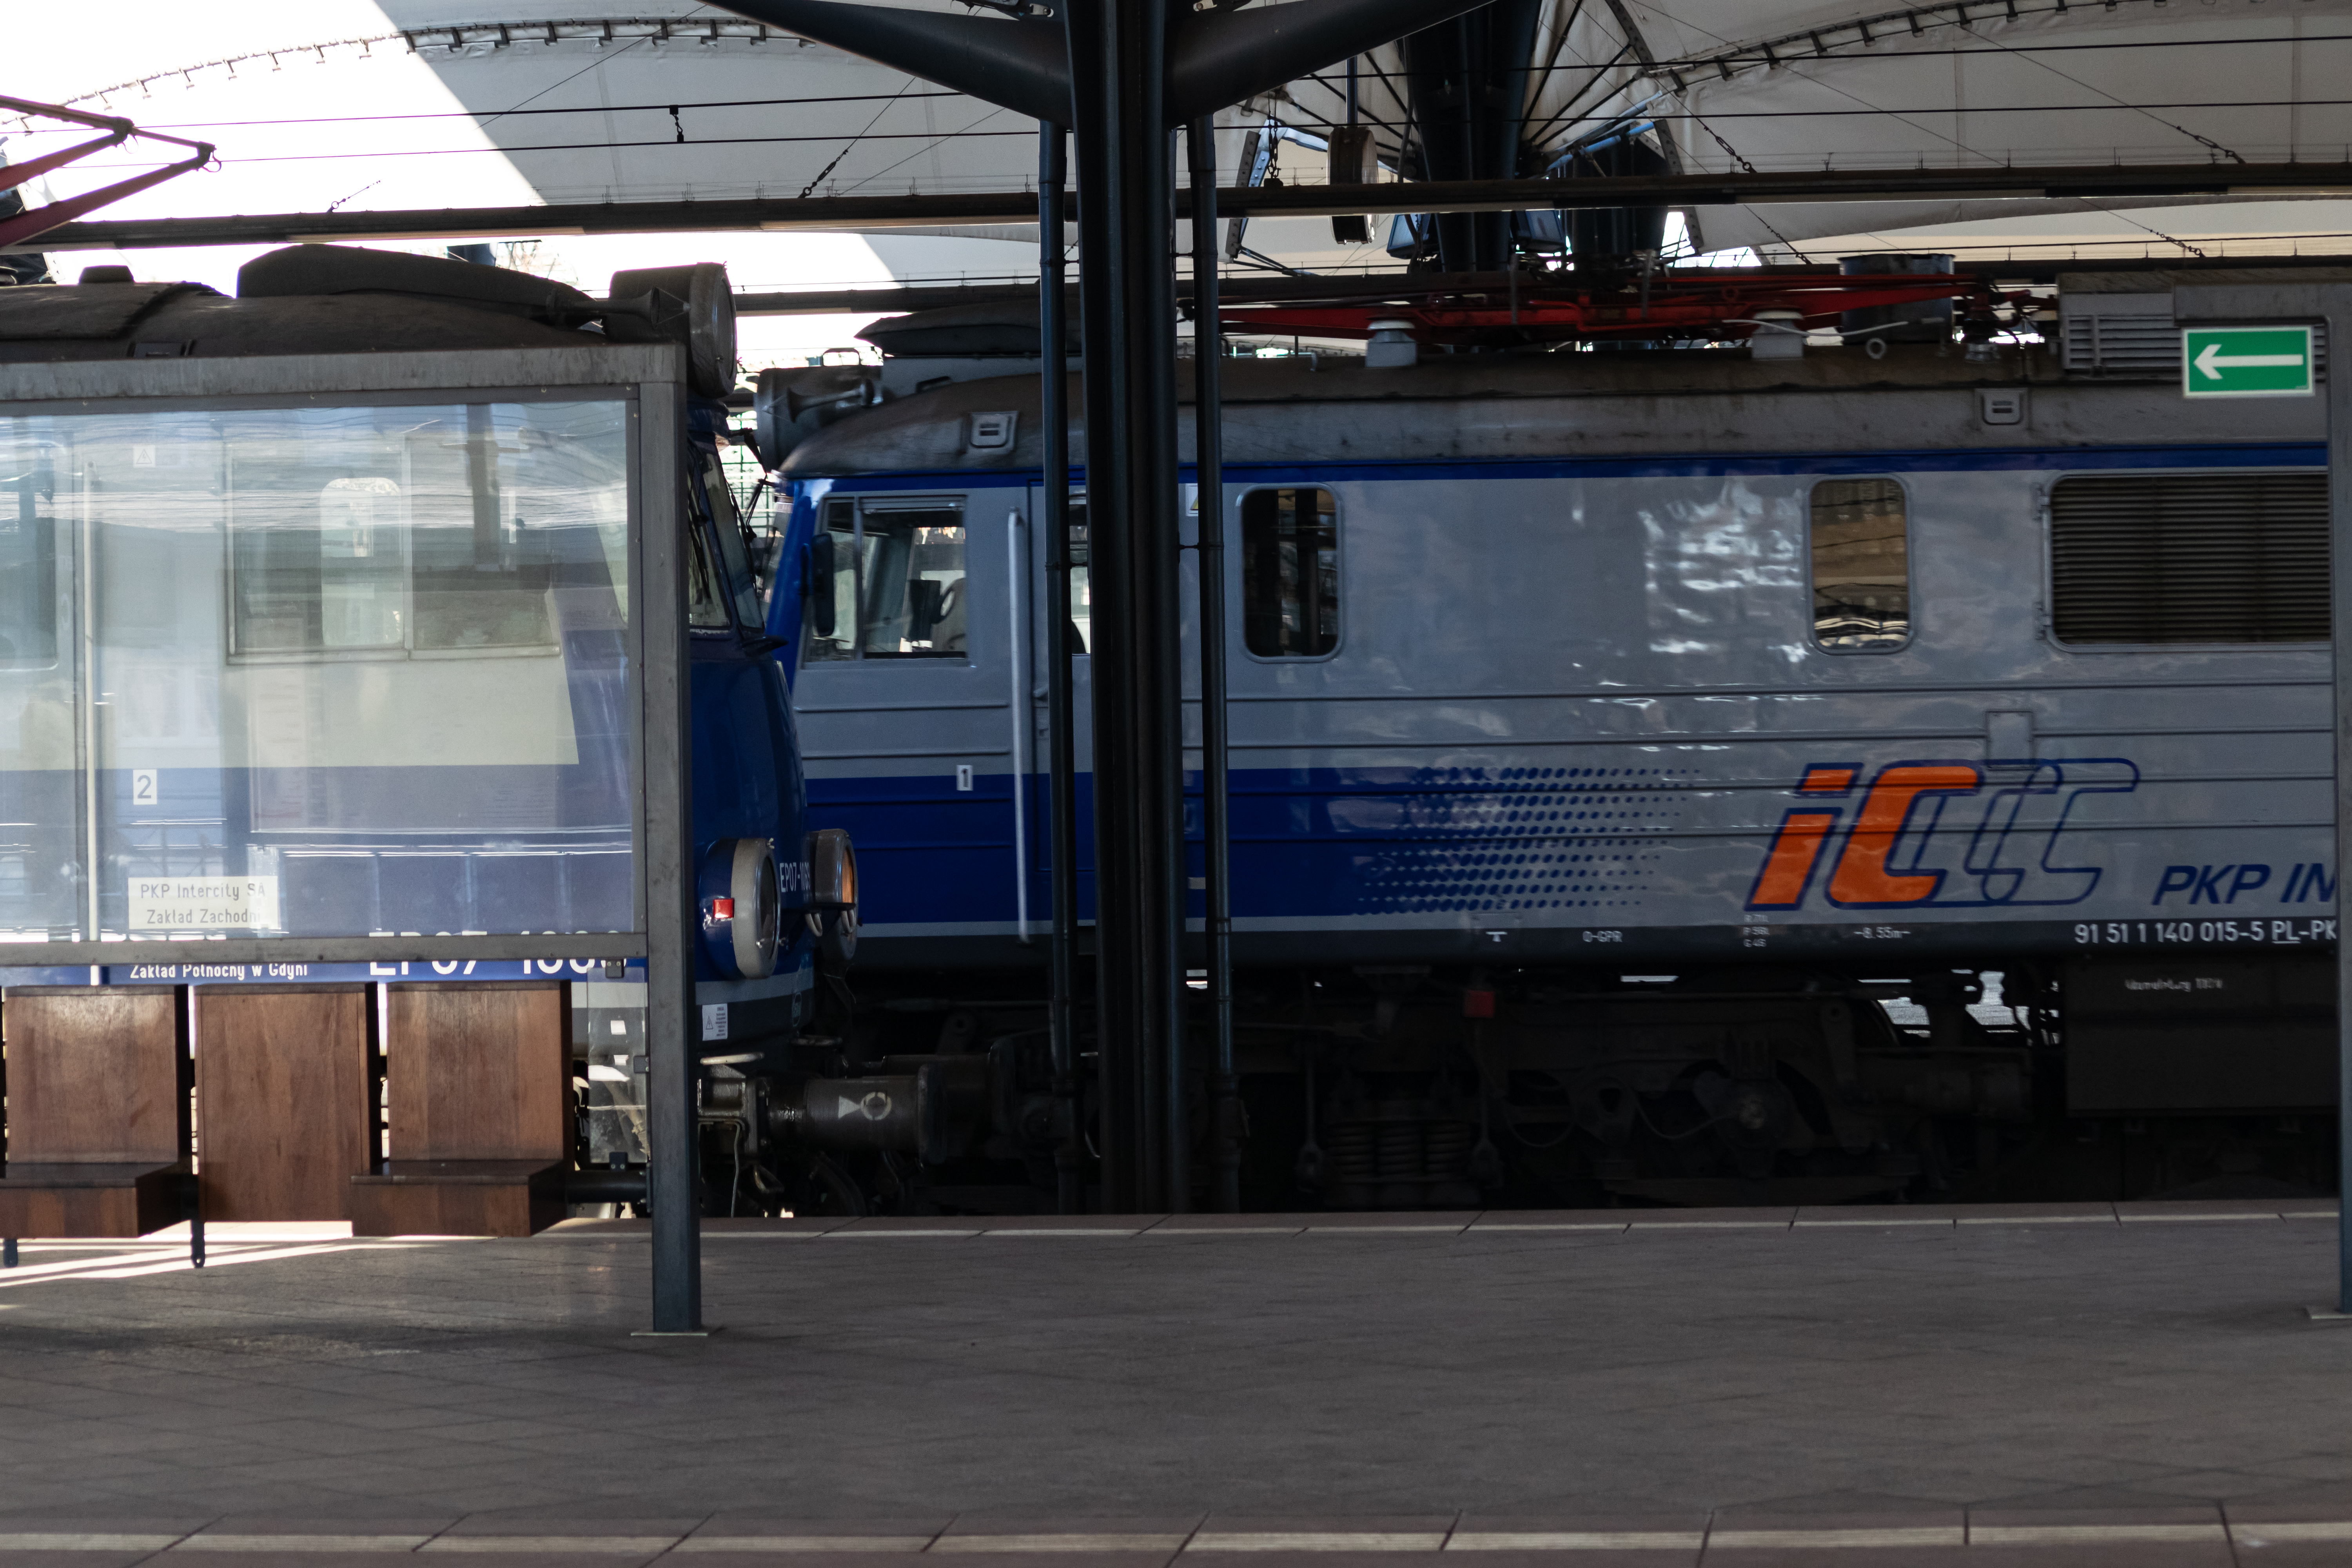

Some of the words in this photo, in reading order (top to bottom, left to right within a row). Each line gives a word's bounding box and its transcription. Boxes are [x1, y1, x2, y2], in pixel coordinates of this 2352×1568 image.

[137, 775, 151, 799] 2
[961, 768, 968, 788] 1
[141, 884, 170, 898] PKP
[178, 883, 239, 901] Intercity
[247, 882, 265, 897] SA
[2152, 864, 2270, 906] PKP
[2279, 863, 2335, 903] IN
[200, 908, 261, 923] Zachodni
[2074, 924, 2098, 943] 91
[2106, 923, 2129, 943] 51
[2137, 923, 2147, 942] 1
[2155, 922, 2194, 942] 140
[2199, 921, 2265, 941] 015-5
[252, 965, 262, 977] w
[269, 964, 307, 980] Gdyni
